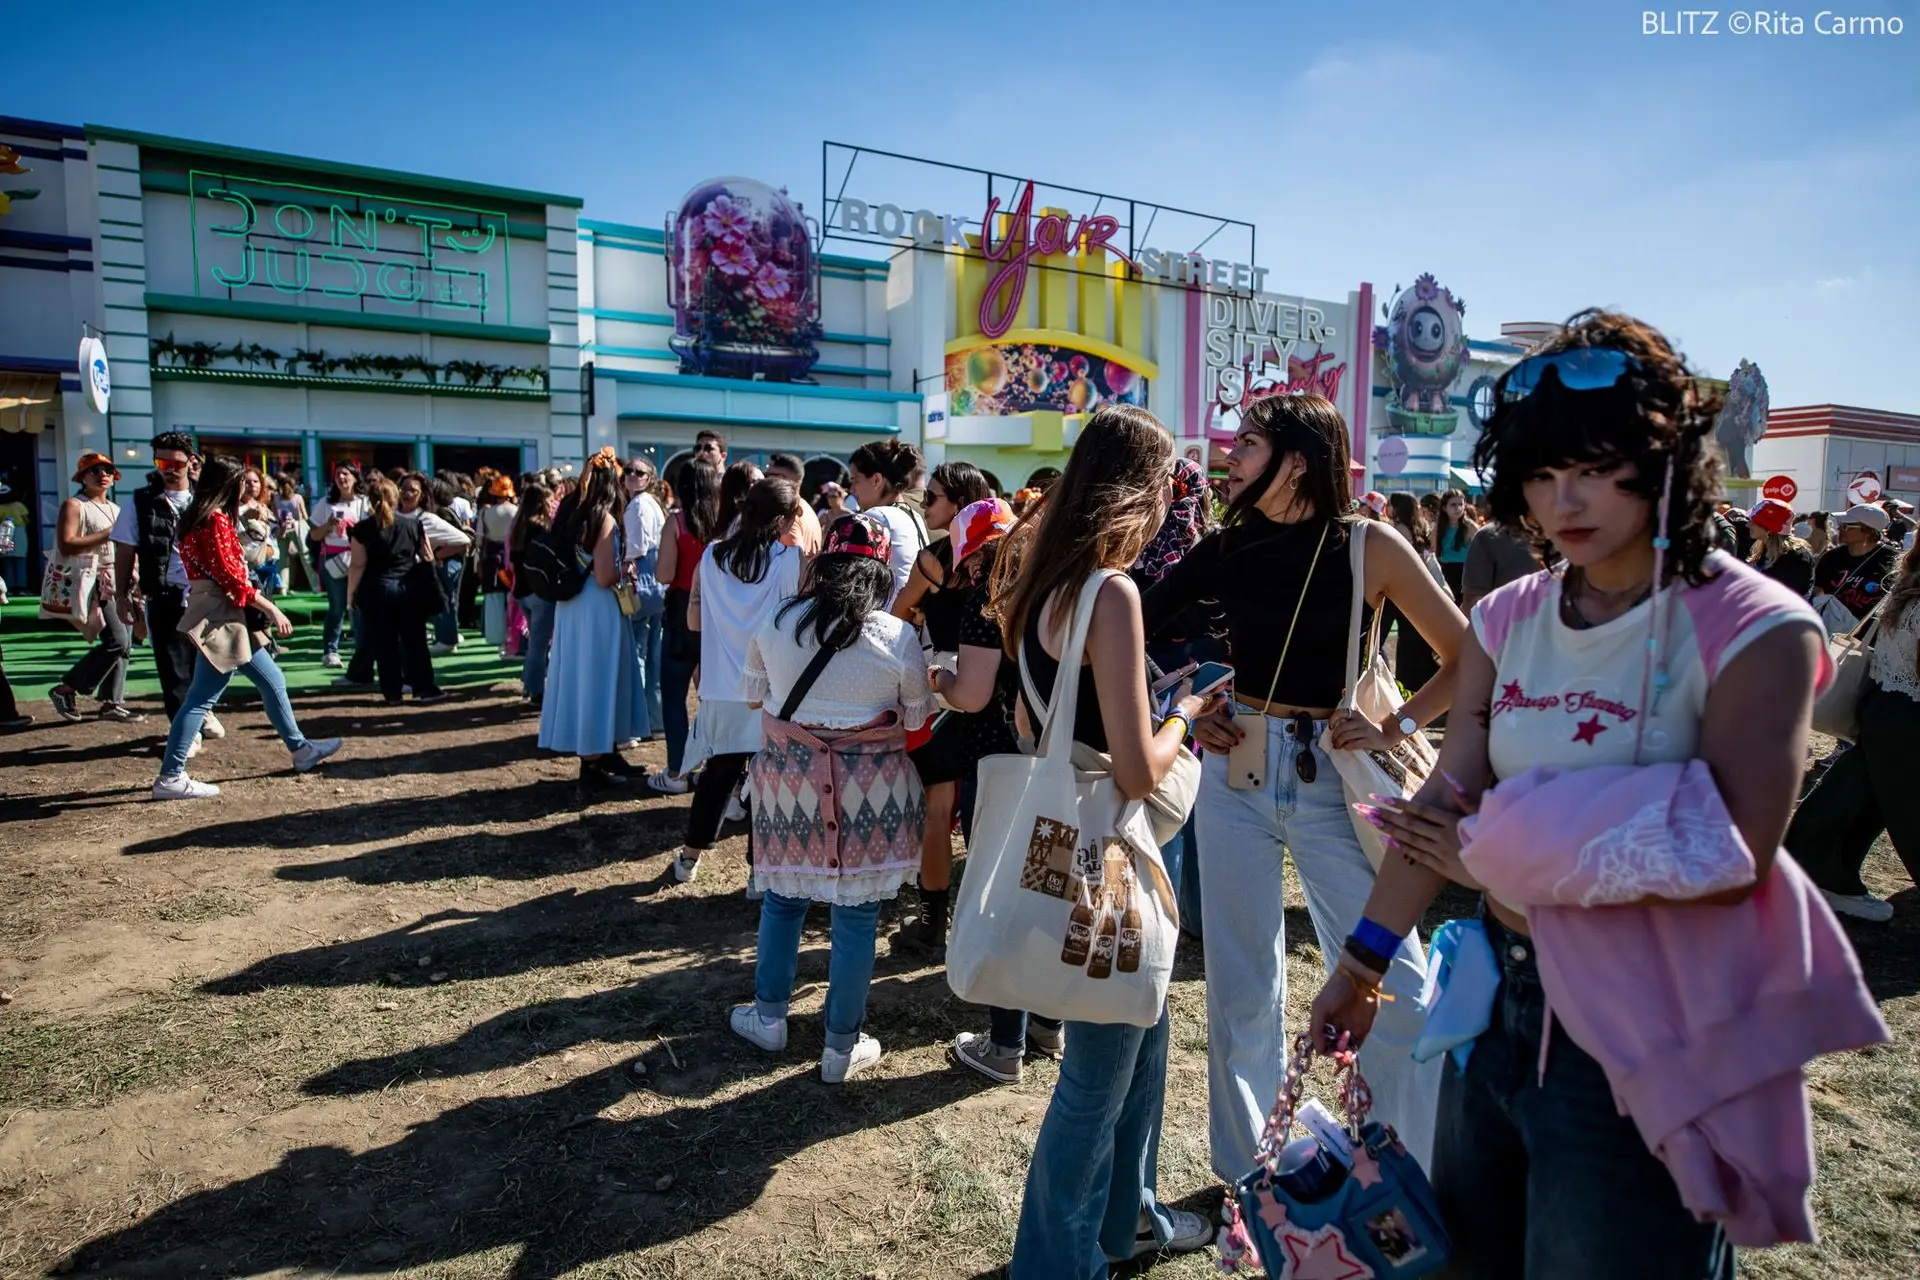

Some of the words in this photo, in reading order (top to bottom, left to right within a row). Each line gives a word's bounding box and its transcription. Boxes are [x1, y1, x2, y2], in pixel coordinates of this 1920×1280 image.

[208, 188, 452, 260] DON'T
[840, 196, 970, 249] ROCK
[1141, 246, 1270, 296] STREET
[211, 242, 489, 314] JUDGE!
[1207, 295, 1336, 344] DIVER-
[1205, 328, 1299, 376] SITY
[1206, 366, 1245, 406] IS
[1764, 486, 1780, 495] galp
